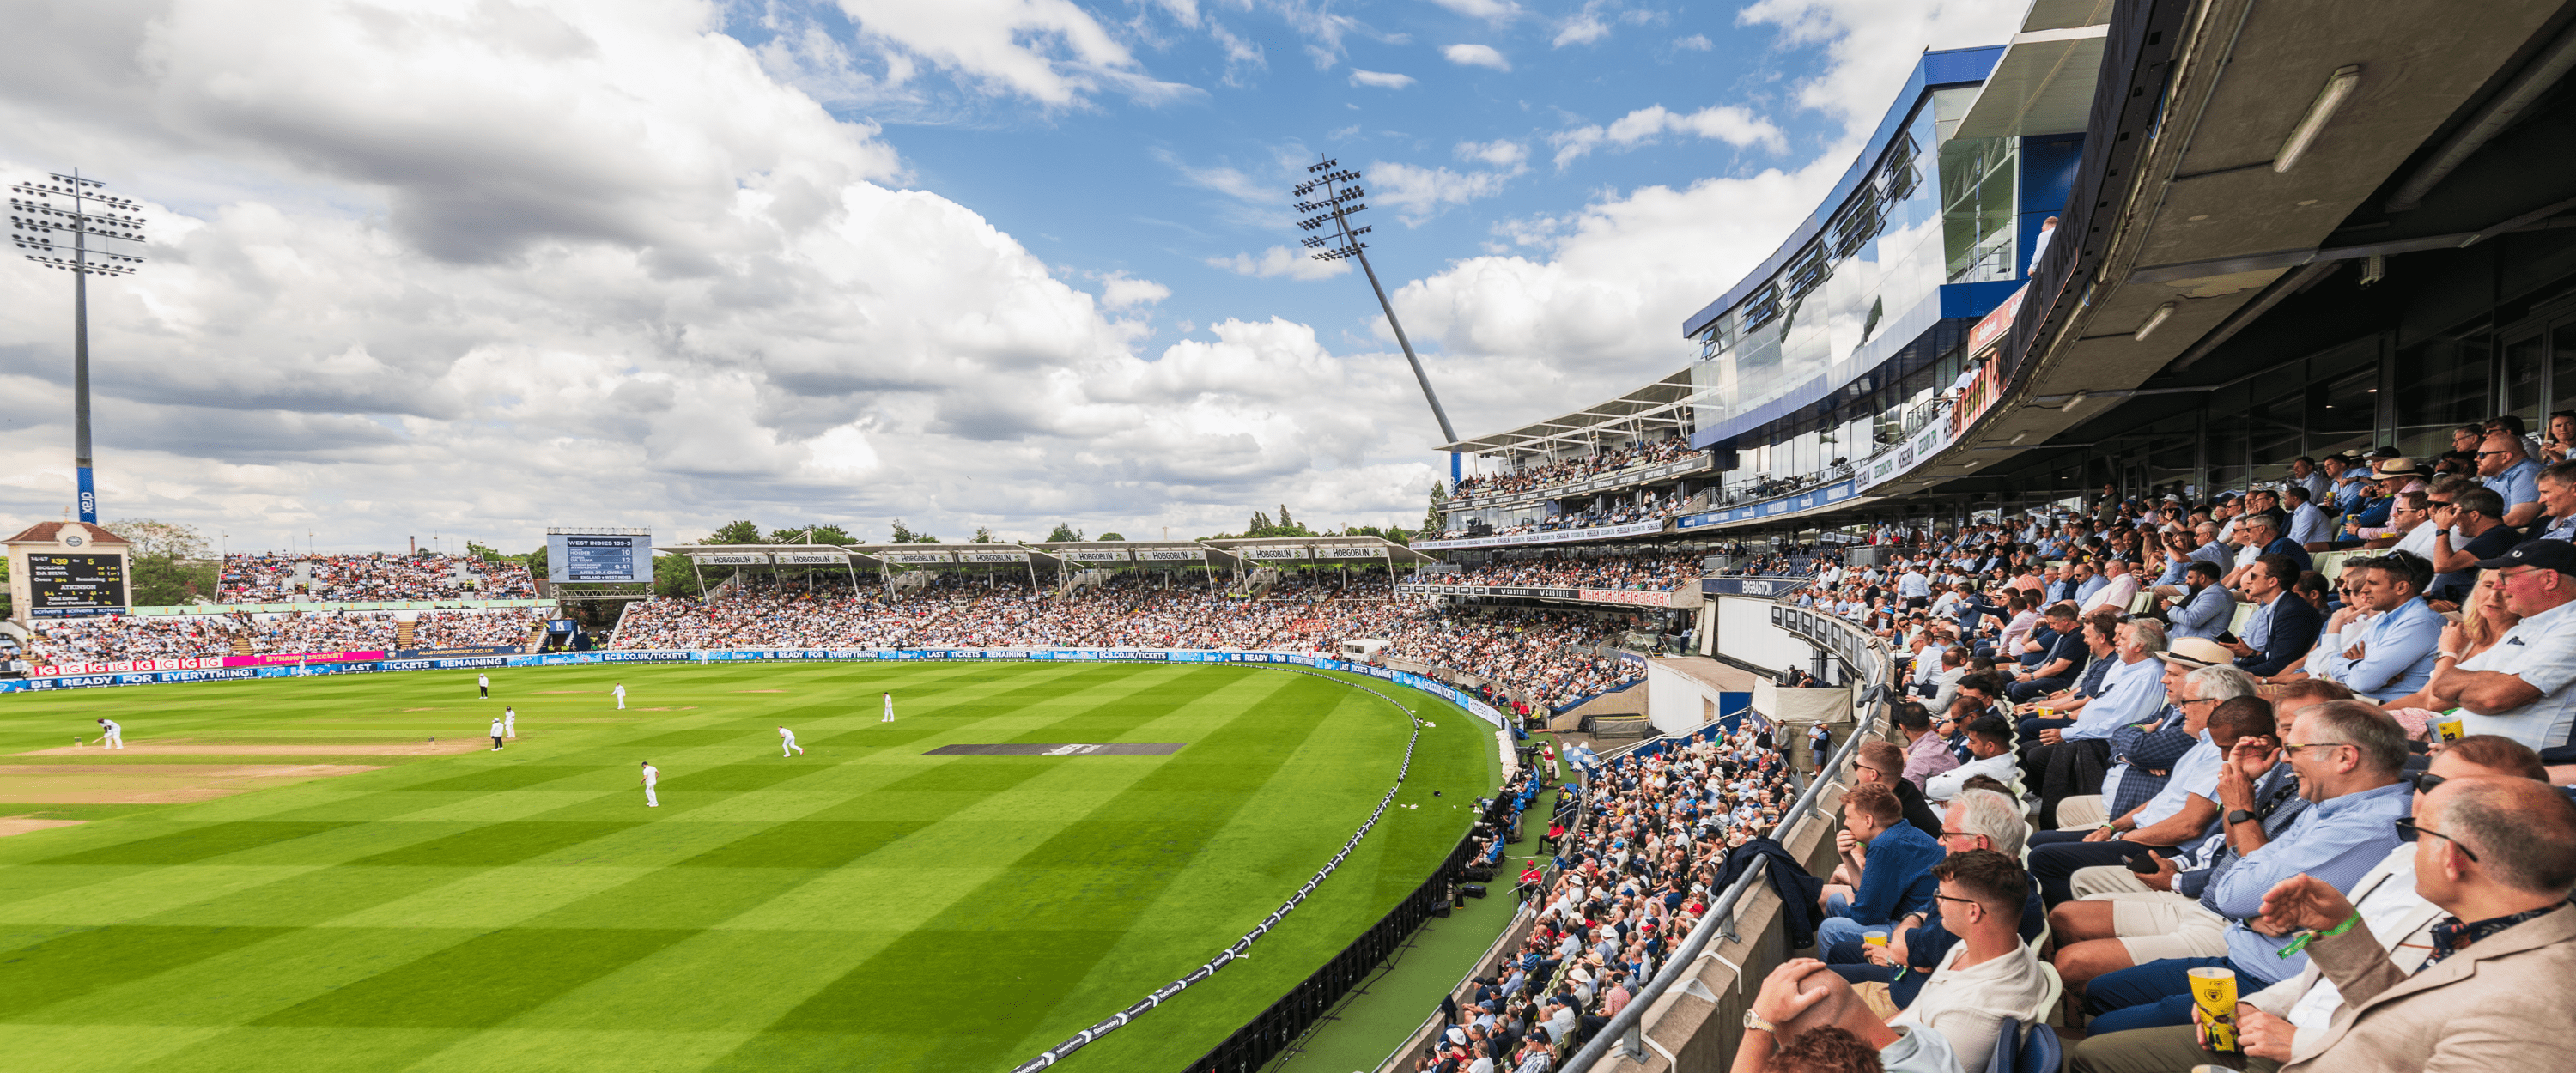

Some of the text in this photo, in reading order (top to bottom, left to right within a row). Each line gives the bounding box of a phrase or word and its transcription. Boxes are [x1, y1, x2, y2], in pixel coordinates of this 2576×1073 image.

[81, 492, 94, 513] drax
[1256, 549, 1291, 558] HOBGOBLIN
[1333, 548, 1370, 557] HOBGOBLIN
[1546, 589, 1569, 597] CASTORE
[1742, 580, 1773, 596] EDGBASTON
[135, 661, 153, 670] IG
[160, 660, 174, 669] IG
[181, 658, 197, 669] IG
[204, 658, 219, 666] IG
[382, 661, 429, 670] TICKETS
[440, 658, 502, 668] REMAINING
[38, 666, 57, 676] IG
[64, 664, 81, 673] IG
[88, 664, 106, 672] IG
[1352, 665, 1368, 674] TICKETS
[1370, 668, 1391, 679] REMAINING
[31, 670, 254, 688] BE READY FOR EVERYTHING!
[1159, 985, 1180, 999] Rothesay
[1093, 1019, 1120, 1034] Rothesay
